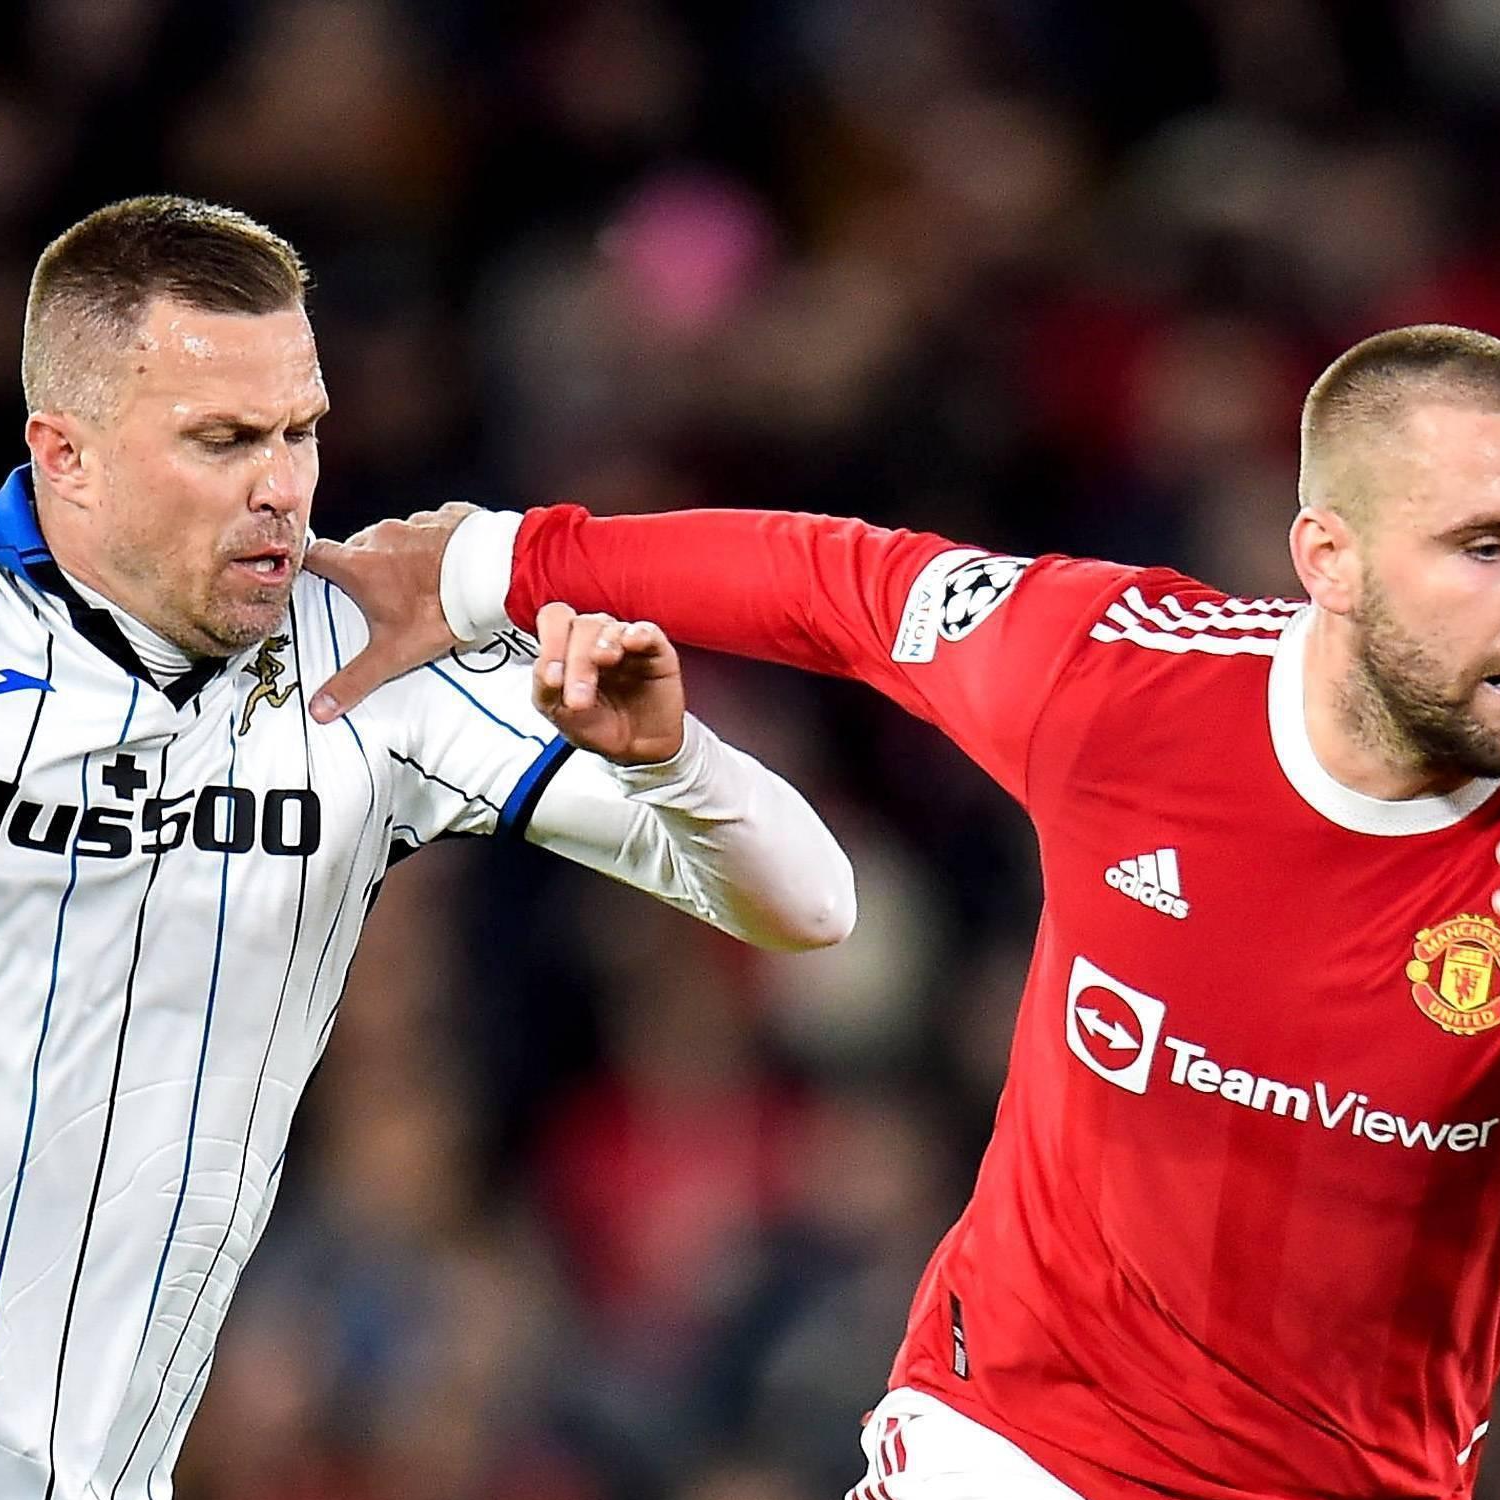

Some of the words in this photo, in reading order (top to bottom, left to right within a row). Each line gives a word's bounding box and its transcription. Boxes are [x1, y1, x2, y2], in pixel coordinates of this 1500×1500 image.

[1103, 865, 1189, 920] adidas
[1427, 1000, 1495, 1027] UNITED
[1164, 1035, 1500, 1152] TeamViewer
